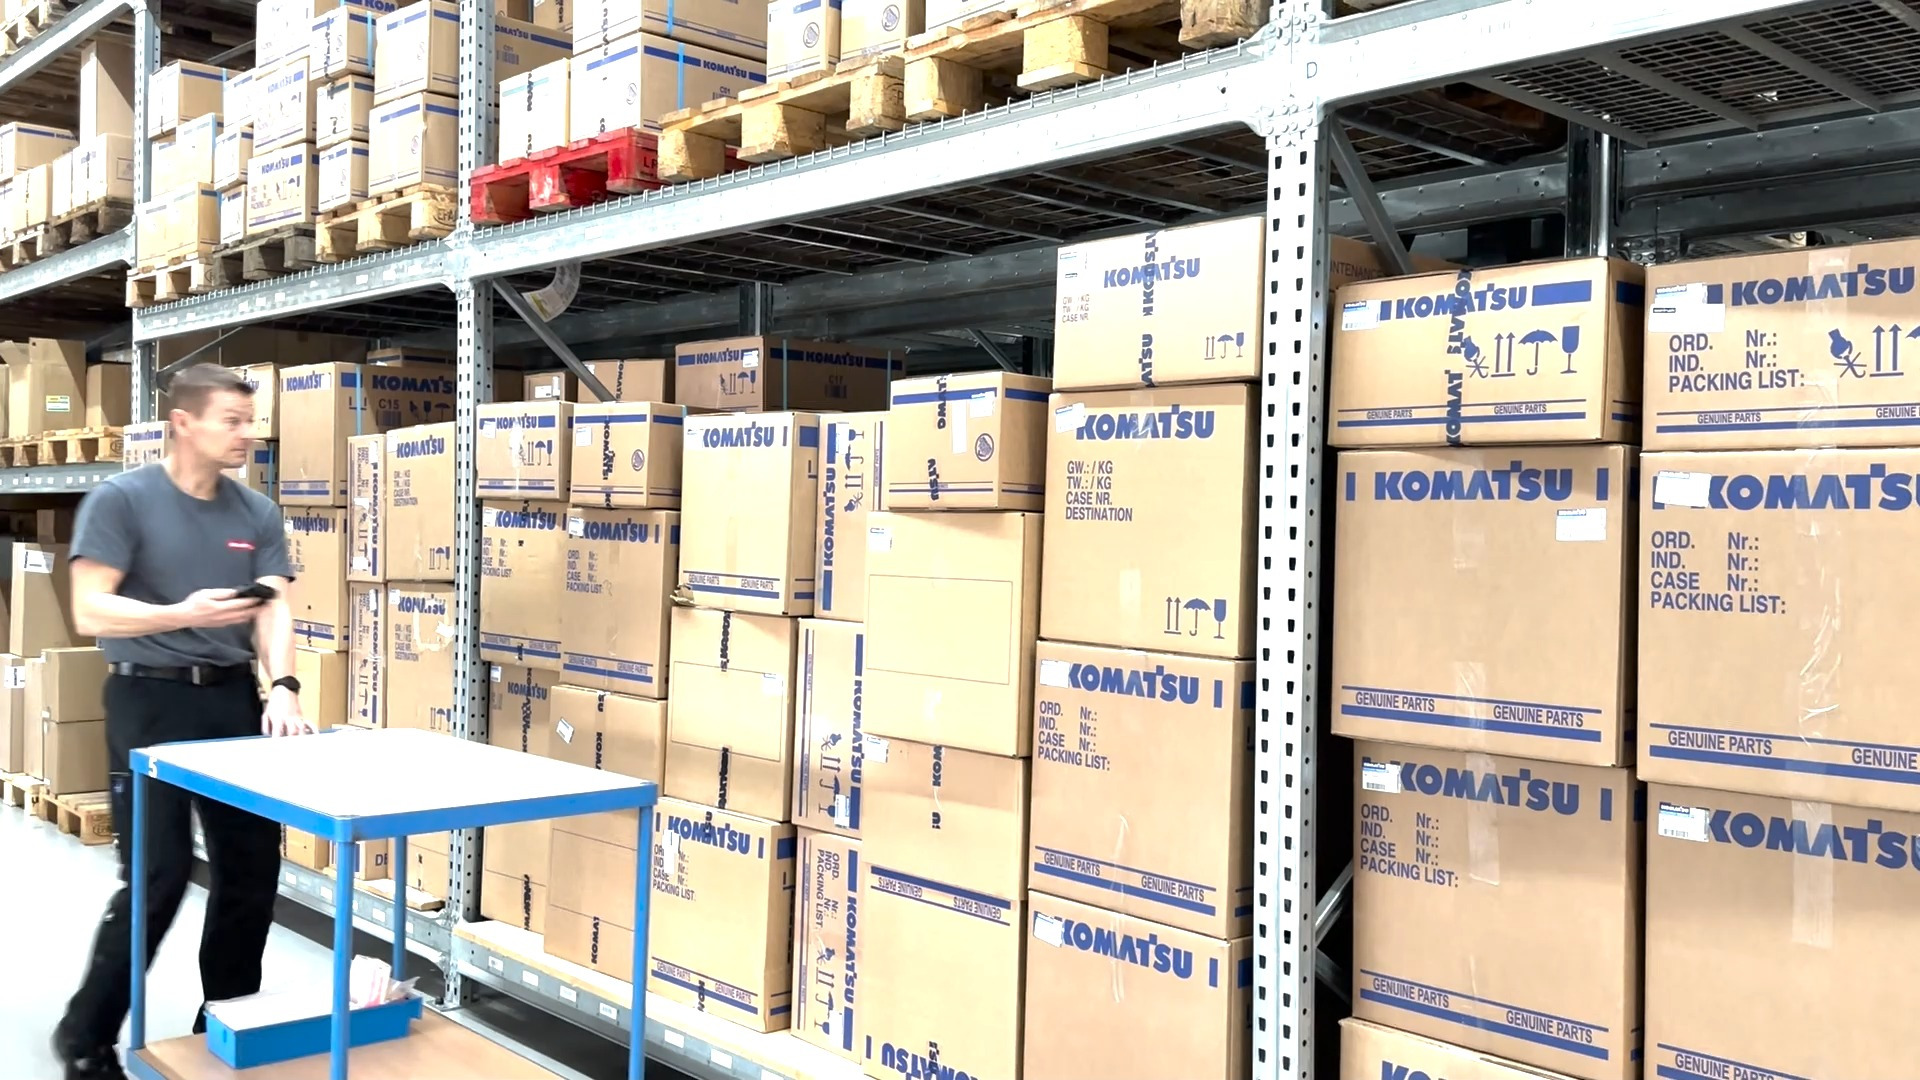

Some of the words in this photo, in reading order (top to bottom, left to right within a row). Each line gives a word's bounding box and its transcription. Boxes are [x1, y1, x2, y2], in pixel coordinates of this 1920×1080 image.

[495, 24, 529, 40] OMATSU
[703, 60, 747, 79] KOMATSU
[1306, 61, 1317, 79] D
[1104, 255, 1200, 288] KOMATSU
[1732, 263, 1915, 307] KOMATSU
[1396, 283, 1527, 319] KOMATSU
[1669, 333, 1713, 352] ORD.
[1746, 329, 1777, 348] Nr.:
[696, 348, 739, 365] KOMATSU
[806, 351, 863, 368] KOMATSU
[1669, 354, 1704, 372] IND.
[1746, 350, 1777, 369] Nr.:
[373, 375, 457, 395] KOMATS
[1669, 372, 1752, 393] PACKING
[1758, 369, 1806, 389] LIST:
[379, 399, 399, 410] C15
[1367, 410, 1392, 420] GENUINE
[1393, 409, 1413, 419] PARTS
[1494, 404, 1523, 415] GENUINE
[1524, 403, 1547, 414] PARTS
[1875, 407, 1916, 418] GENUINE
[1076, 404, 1214, 440] KOMATSU
[1697, 413, 1733, 424] GENUINE
[1734, 412, 1761, 423] PARTS
[396, 435, 444, 459] KOMATSU
[1375, 460, 1572, 501] KOMATSU
[1066, 492, 1092, 505] CASE
[1096, 492, 1112, 506] NR.
[292, 514, 329, 533] KOMATSU
[495, 507, 556, 531] KOMATSU
[823, 468, 836, 566] KOMATSU
[1065, 507, 1132, 522] DESTINATION
[583, 518, 648, 543] KOMATSU
[1651, 531, 1695, 549] ORD.
[1728, 532, 1759, 550] Nr.:
[1651, 551, 1685, 569] IND.
[1728, 553, 1758, 571] Nr.:
[566, 571, 581, 581] CASE
[1651, 572, 1700, 590] CASE
[1727, 573, 1758, 592] Nr.:
[1651, 591, 1733, 612] PACKING
[1739, 594, 1786, 614] LIST:
[1040, 701, 1063, 716] ORD.
[1356, 691, 1399, 709] GENUINE
[1402, 696, 1435, 712] PARTS
[1039, 716, 1058, 731] IND.
[1493, 705, 1542, 723] GENUINE
[1546, 710, 1583, 728] PARTS
[851, 680, 864, 784] KOMATSU
[1038, 731, 1065, 747] CASE
[1668, 730, 1724, 751] GENUINE
[1729, 736, 1772, 755] PARTS
[148, 756, 158, 779] 5
[1038, 746, 1082, 765] PACKING
[1085, 755, 1110, 771] LIST:
[1852, 748, 1917, 770] GENUINE
[1361, 804, 1392, 823] ORD.
[1416, 812, 1439, 831] Nr.:
[668, 815, 750, 855] KOMATSU
[1361, 821, 1386, 839] IND.
[1416, 830, 1439, 848] Nr.:
[1360, 838, 1396, 859] CASE
[1416, 848, 1439, 866] Nr.:
[816, 849, 825, 900] PACKING
[1044, 852, 1075, 871] GENUINE
[1077, 859, 1100, 876] PARTS
[1360, 856, 1420, 881] PACKING
[1425, 867, 1459, 888] LIST:
[653, 879, 680, 898] PACKING
[878, 877, 897, 890] PARTS
[1141, 875, 1176, 895] GENUINE
[1178, 884, 1205, 902] PARTS
[953, 896, 972, 912] PARTS
[844, 896, 857, 1004] KOMATSU
[1373, 978, 1415, 1000] GENUINE
[1418, 988, 1449, 1008] PARTS
[1506, 1010, 1553, 1034] GENUINE
[1556, 1022, 1593, 1044] PARTS
[1675, 1053, 1730, 1079] GENUINE
